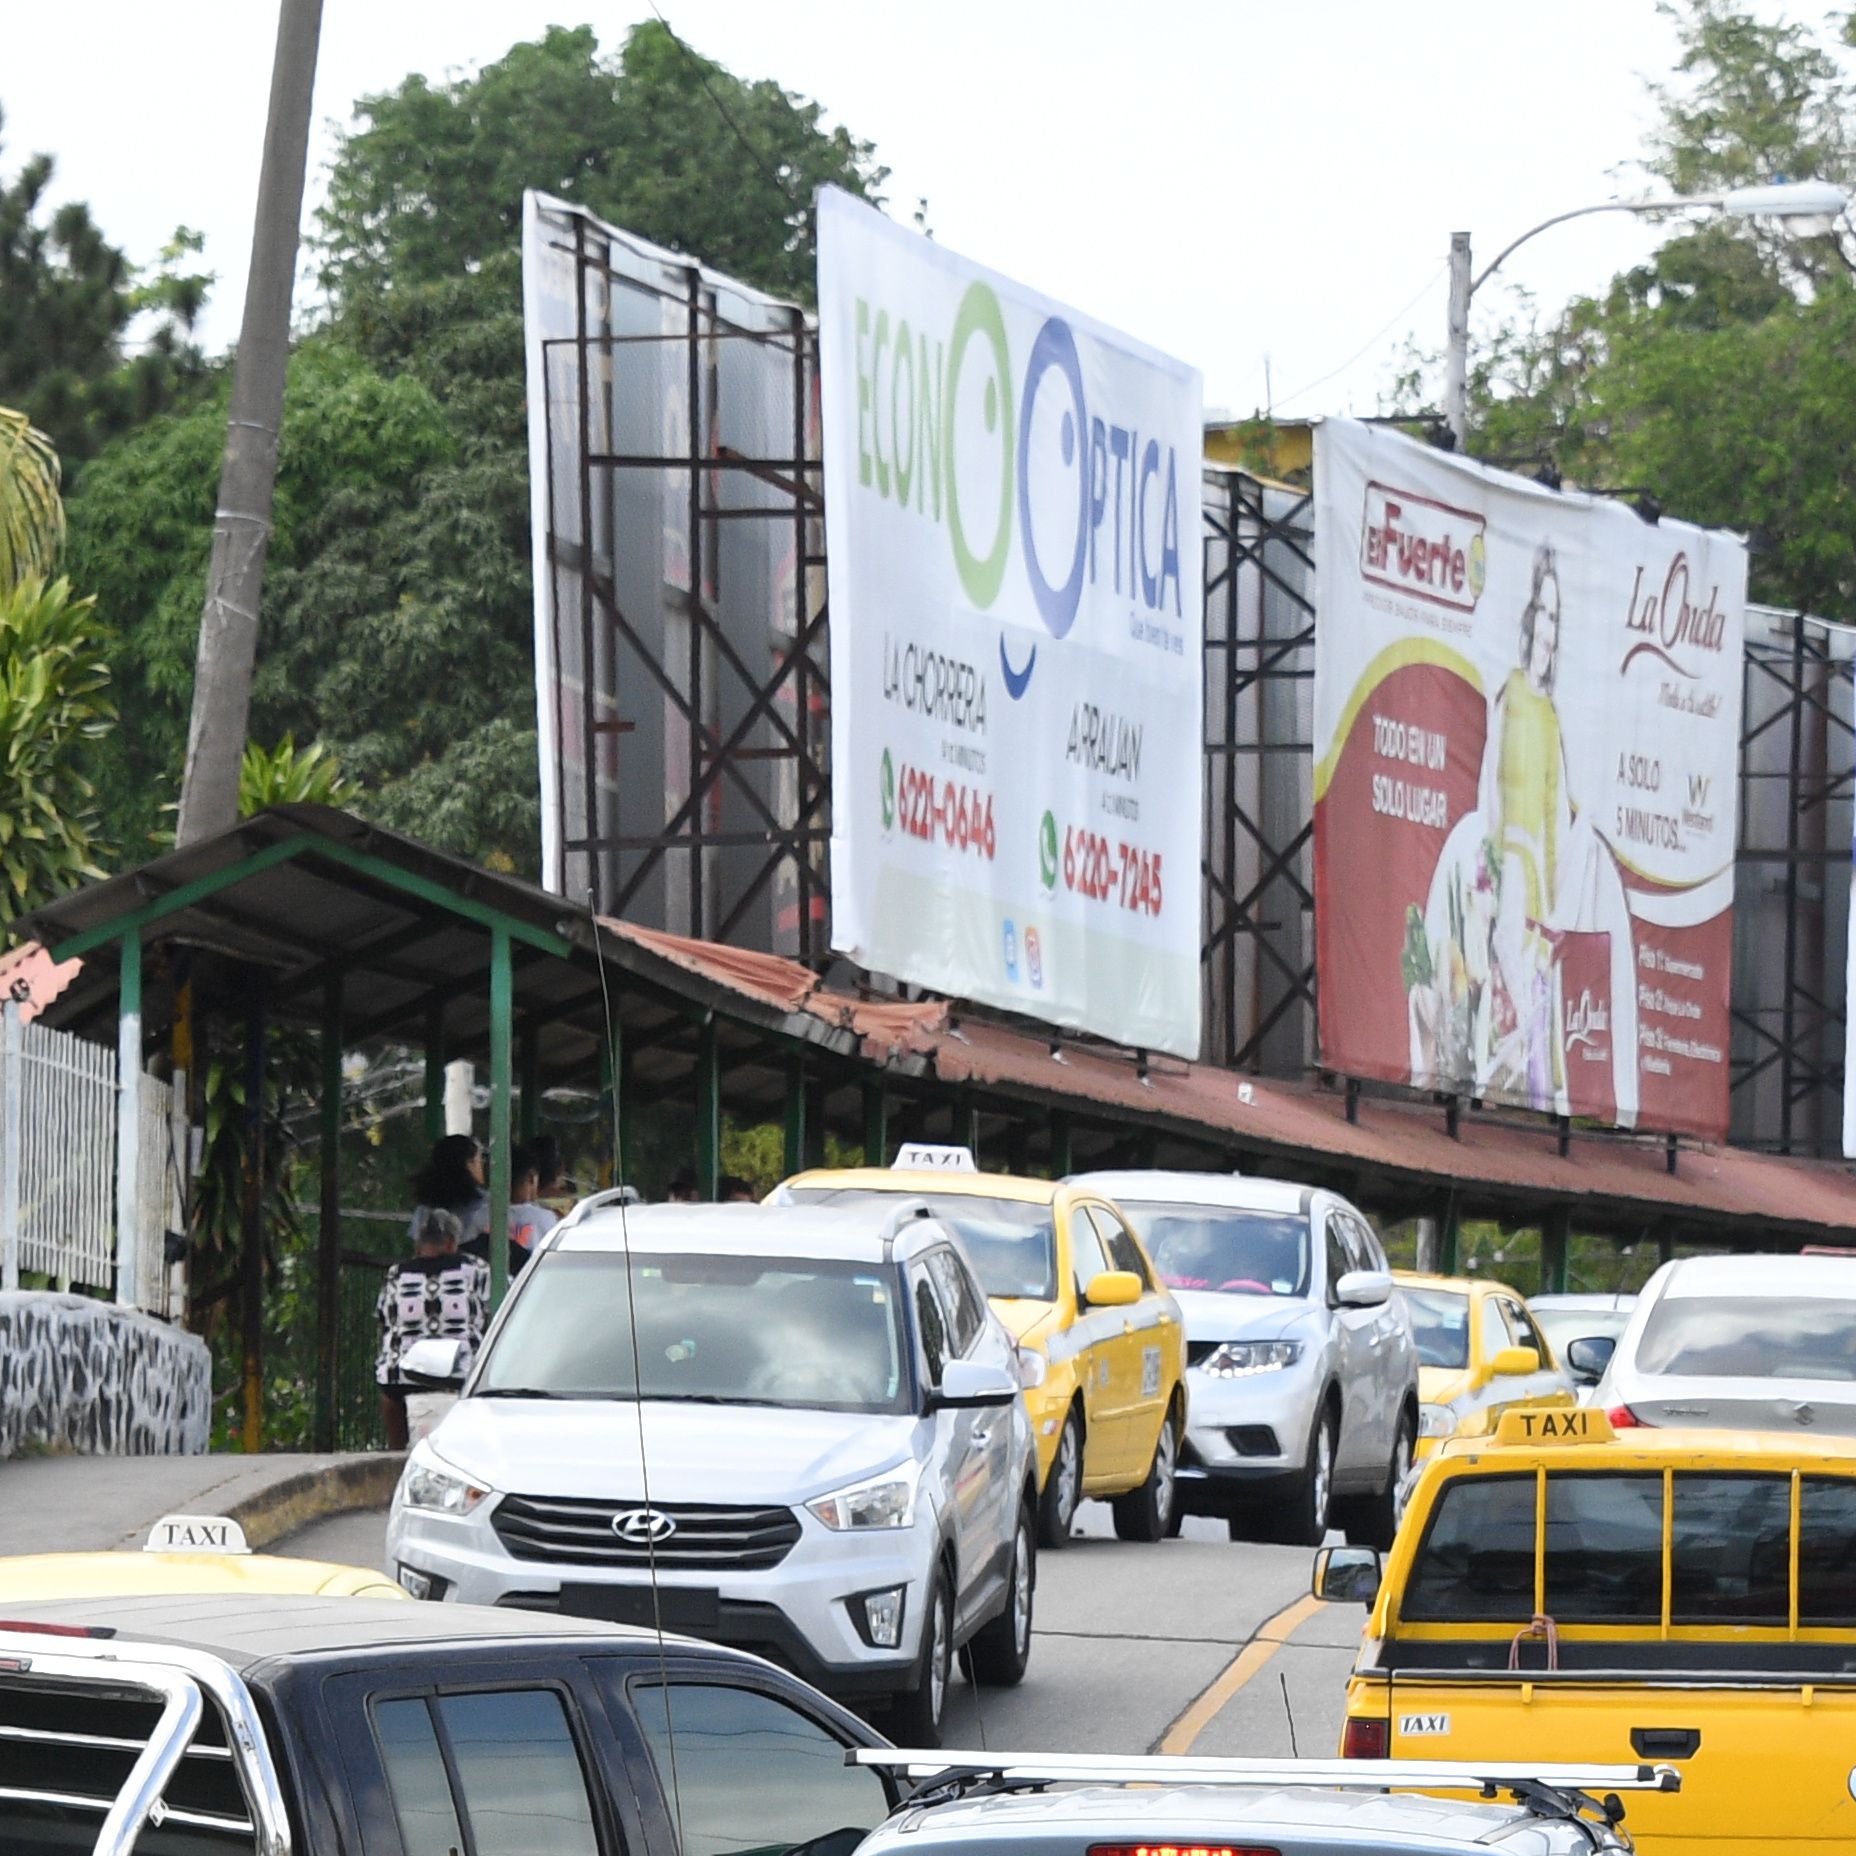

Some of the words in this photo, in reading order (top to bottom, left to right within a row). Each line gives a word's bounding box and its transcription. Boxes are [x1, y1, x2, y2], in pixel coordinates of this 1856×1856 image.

[1382, 501, 1466, 594] Fuerte
[1625, 565, 1656, 635] La
[1660, 550, 1726, 653] Onda
[884, 633, 898, 700] LA
[902, 643, 986, 735] CHORRERA
[1373, 714, 1404, 760] TODO
[1407, 725, 1426, 764] EN
[1428, 732, 1447, 771] UN
[1616, 752, 1626, 785] A
[1628, 755, 1660, 792] SOLO
[898, 764, 996, 861] 6221-0646
[1372, 773, 1404, 820] SOLO
[1407, 783, 1447, 829] LUGAR
[1617, 805, 1623, 838] 5
[1063, 825, 1163, 919] 6220-7245
[909, 1151, 962, 1167] TAXI
[1520, 1413, 1589, 1437] TAXI
[164, 1521, 229, 1547] TAXI
[1399, 1714, 1447, 1734] TAXI
